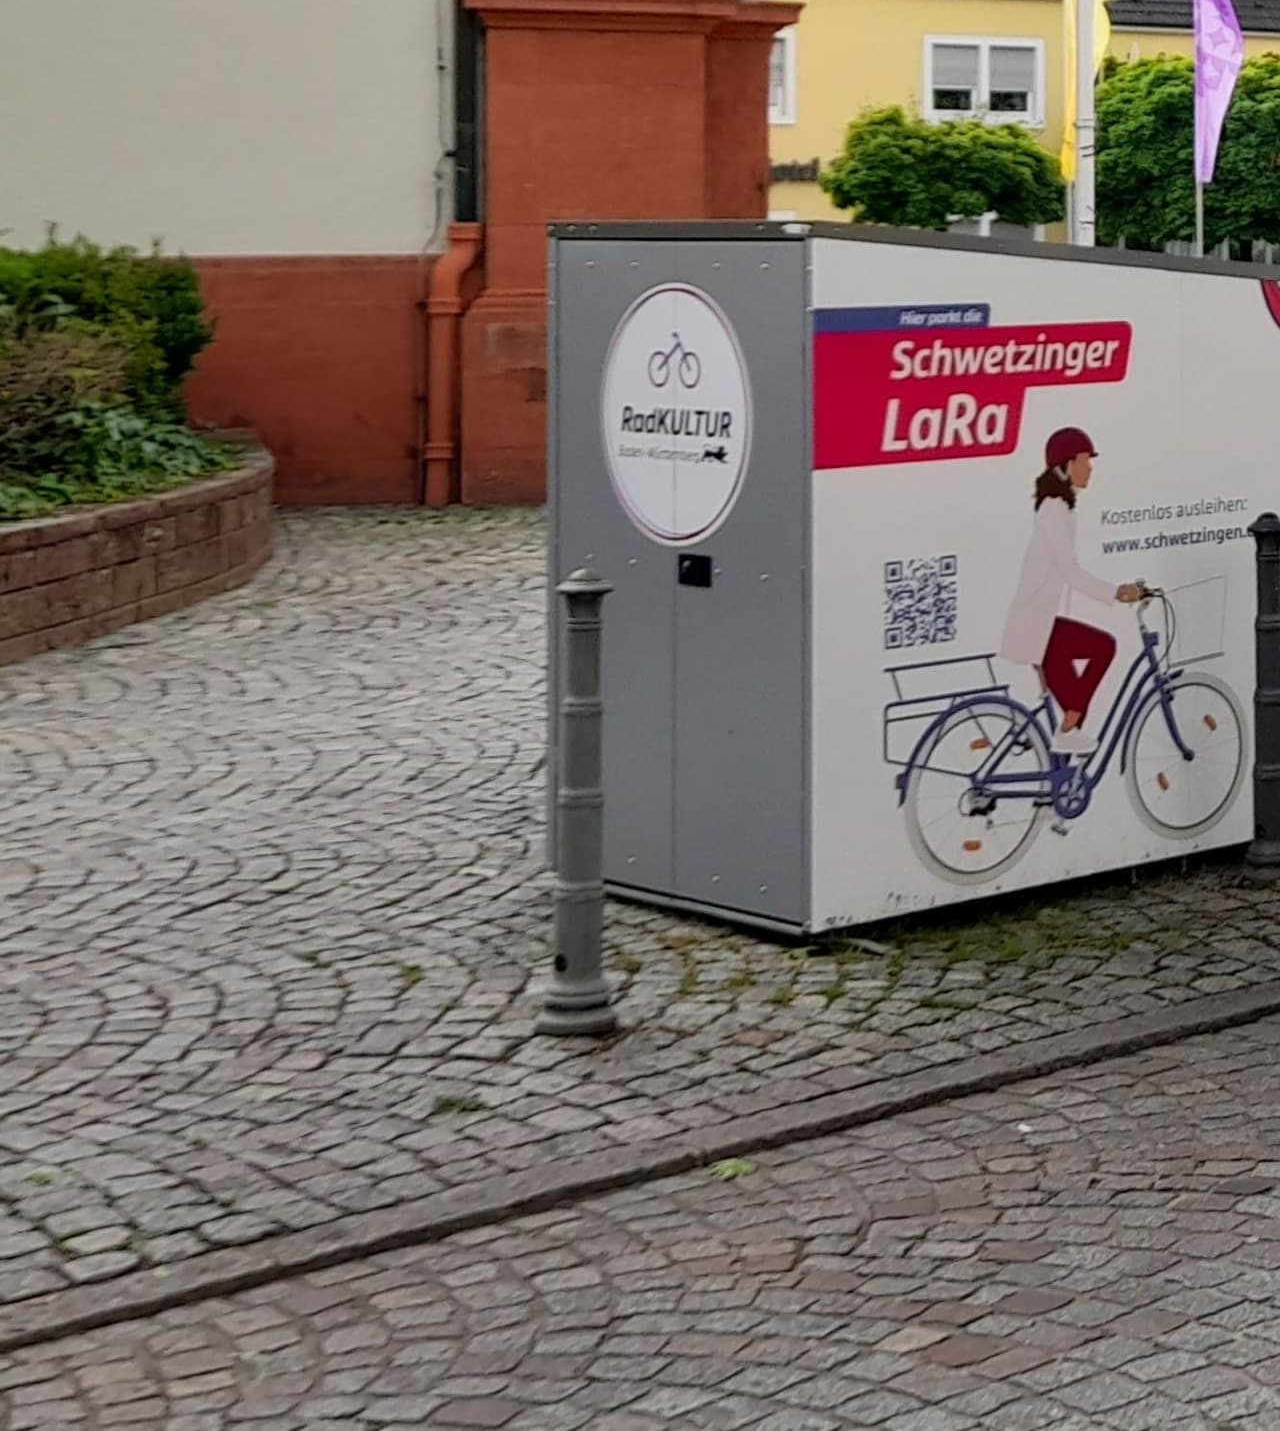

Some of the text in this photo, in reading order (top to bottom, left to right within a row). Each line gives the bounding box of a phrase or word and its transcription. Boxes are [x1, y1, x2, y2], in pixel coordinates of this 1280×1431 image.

[900, 307, 983, 327] Hier parkt die
[890, 333, 1121, 380] Schwetzinger
[620, 405, 733, 439] RadKULTUR
[880, 393, 1009, 453] LaRa
[1100, 497, 1249, 525] Kostenlos ausleihen:
